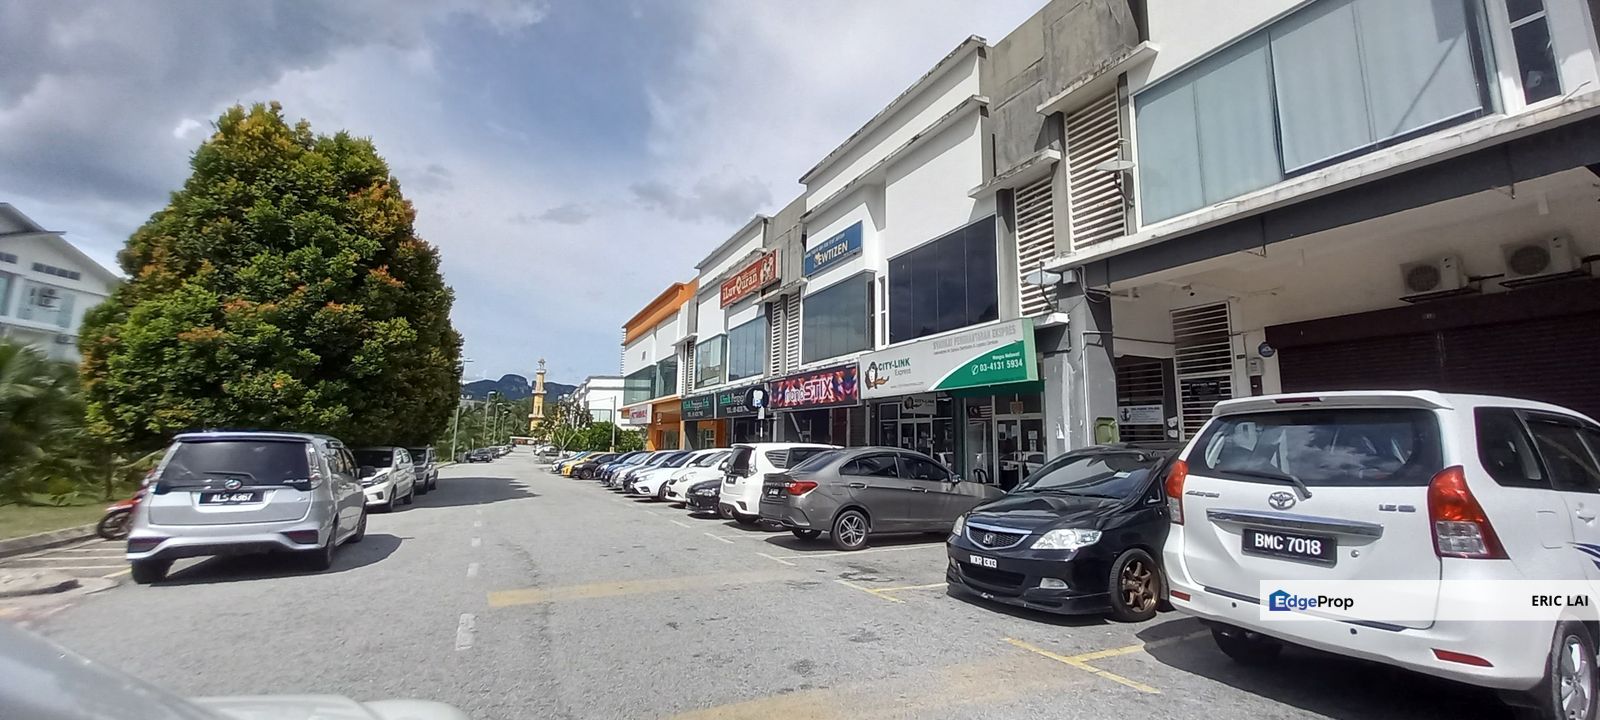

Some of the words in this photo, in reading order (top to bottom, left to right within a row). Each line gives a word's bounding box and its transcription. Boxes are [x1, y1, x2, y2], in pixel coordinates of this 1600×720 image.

[878, 357, 911, 371] CITY-LINK
[979, 361, 1004, 372] 03-4131
[1006, 358, 1023, 369] 5934
[1254, 532, 1283, 549] BMC
[1286, 536, 1322, 556] 7018
